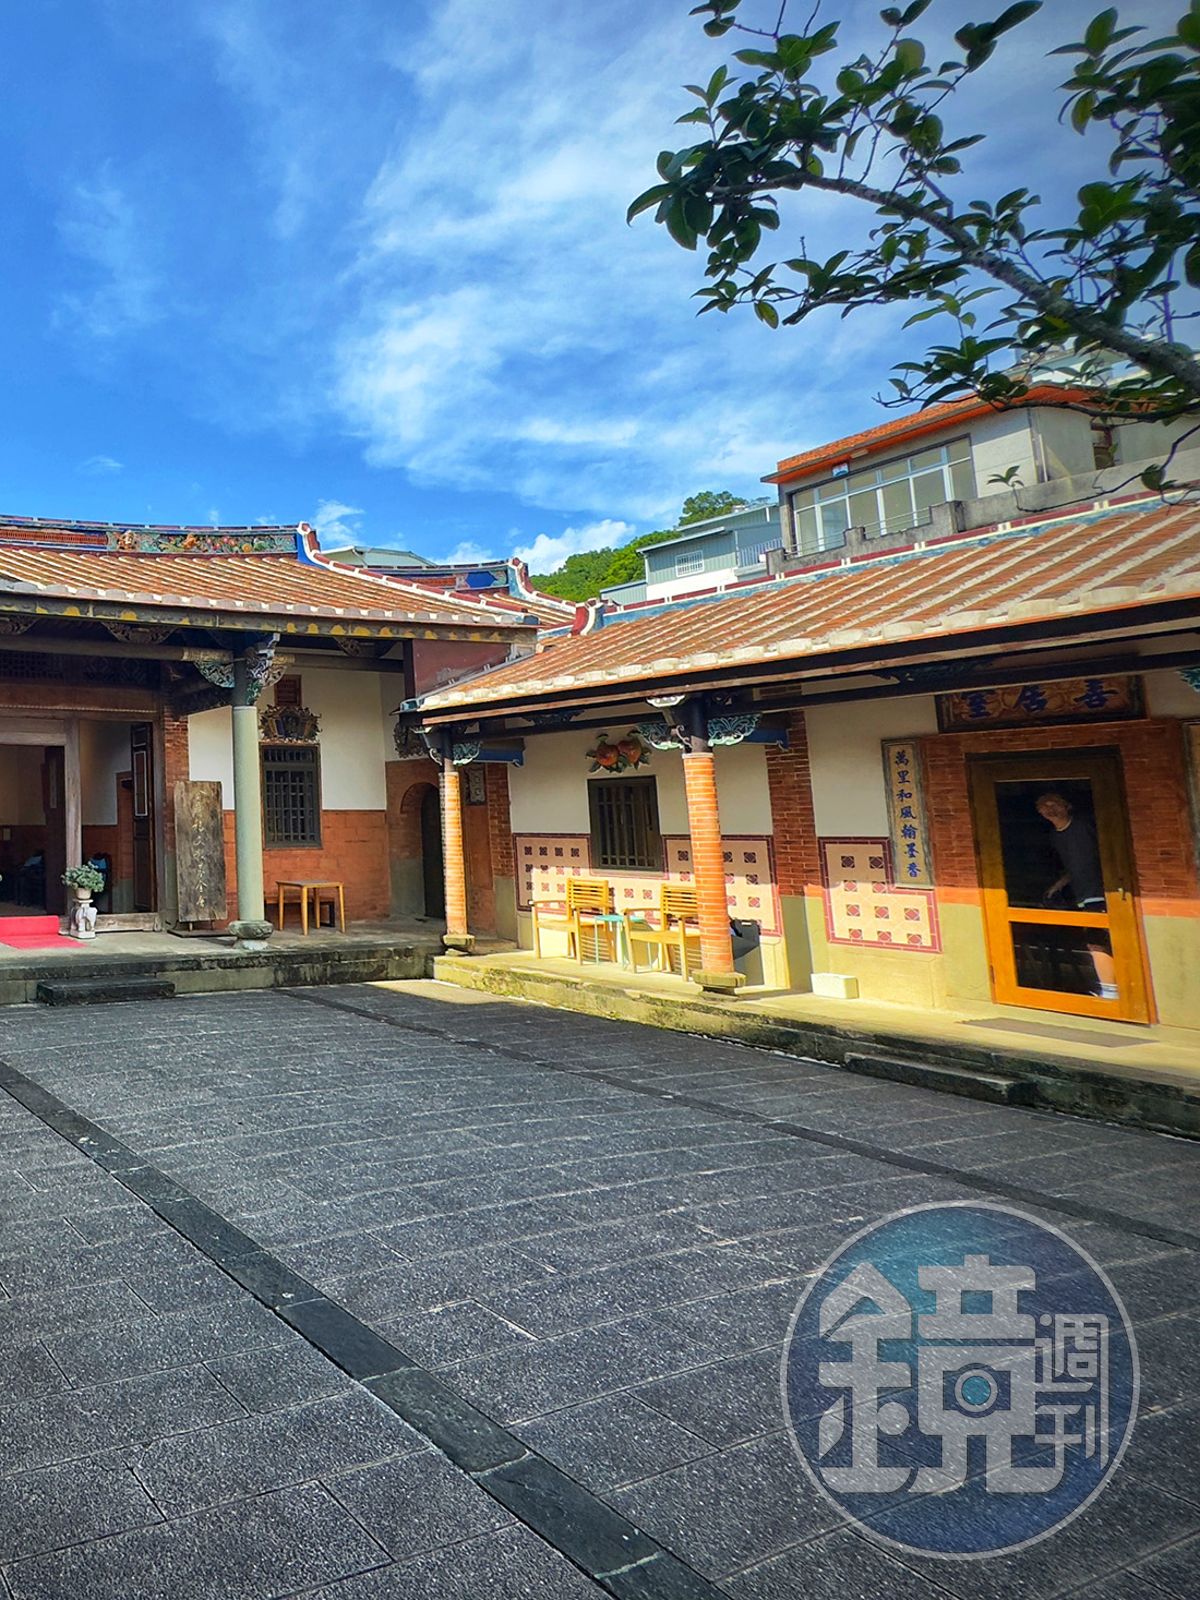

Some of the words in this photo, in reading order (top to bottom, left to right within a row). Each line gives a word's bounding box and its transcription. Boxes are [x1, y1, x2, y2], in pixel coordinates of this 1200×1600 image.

[894, 749, 922, 878] 萬里和風翰墨香
